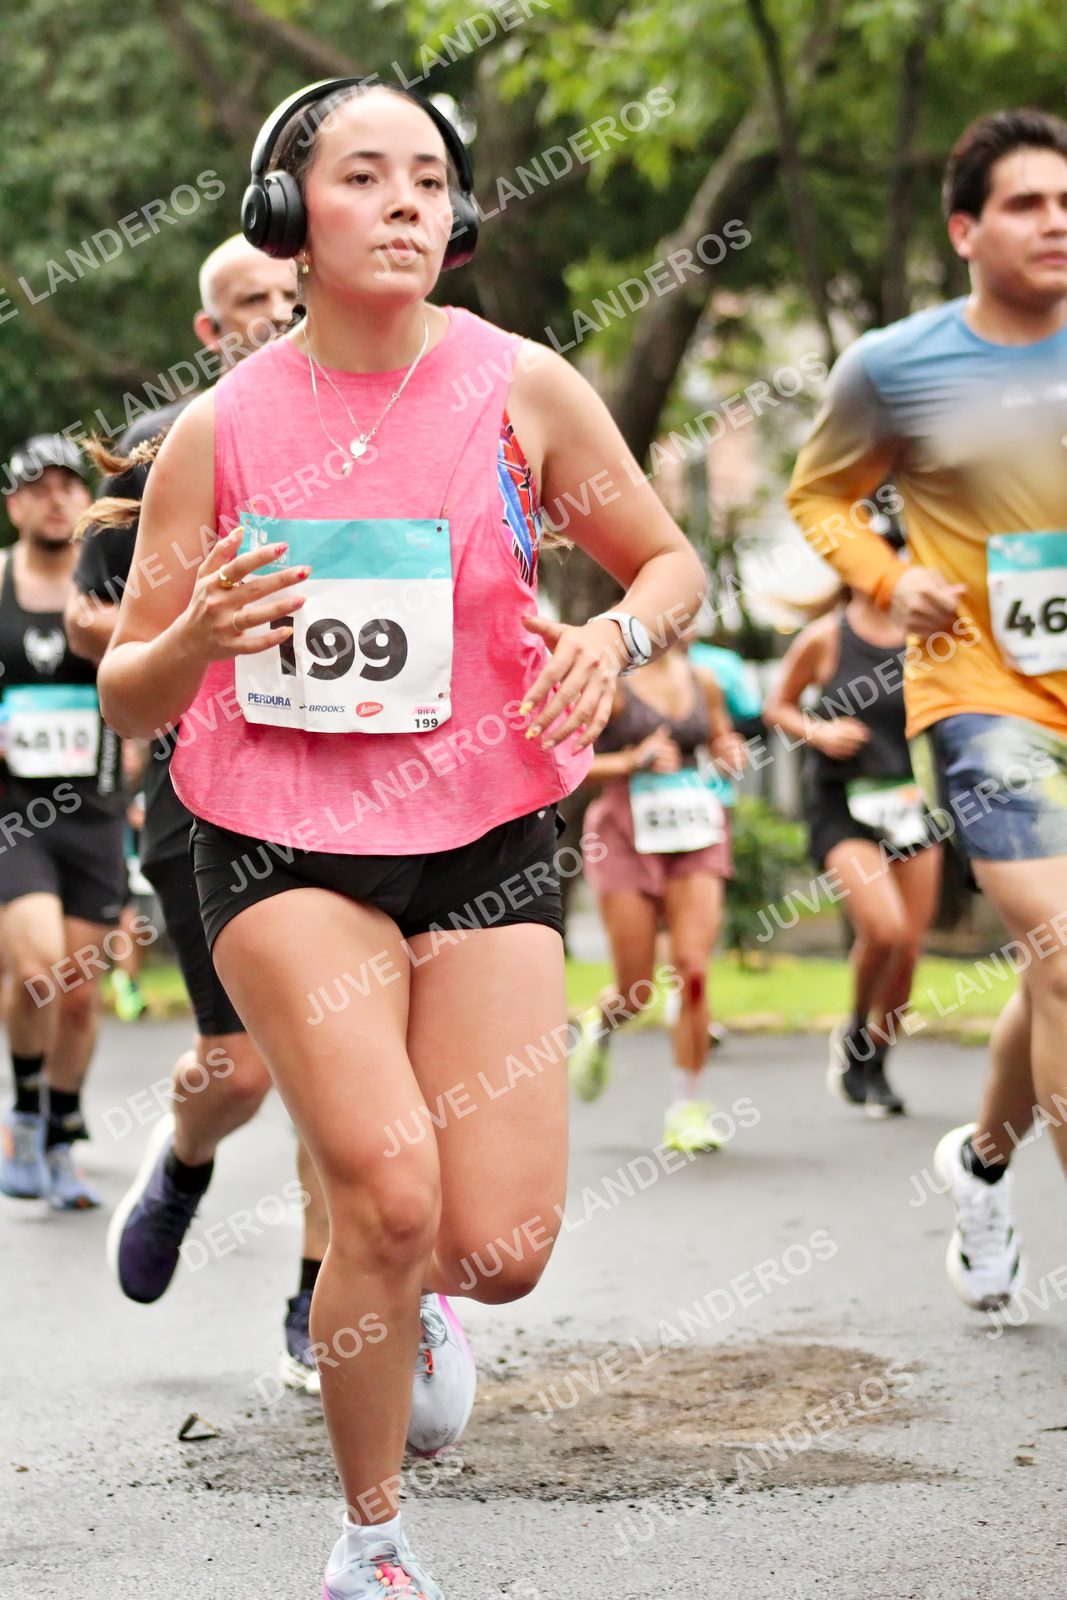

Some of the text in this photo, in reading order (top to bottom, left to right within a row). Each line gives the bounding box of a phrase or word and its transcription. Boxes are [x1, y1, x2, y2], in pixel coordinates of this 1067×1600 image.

[1005, 597, 1067, 638] 46
[270, 615, 408, 682] 199
[248, 692, 291, 707] PERDURA
[308, 704, 345, 713] BROOKS
[415, 718, 438, 728] 199
